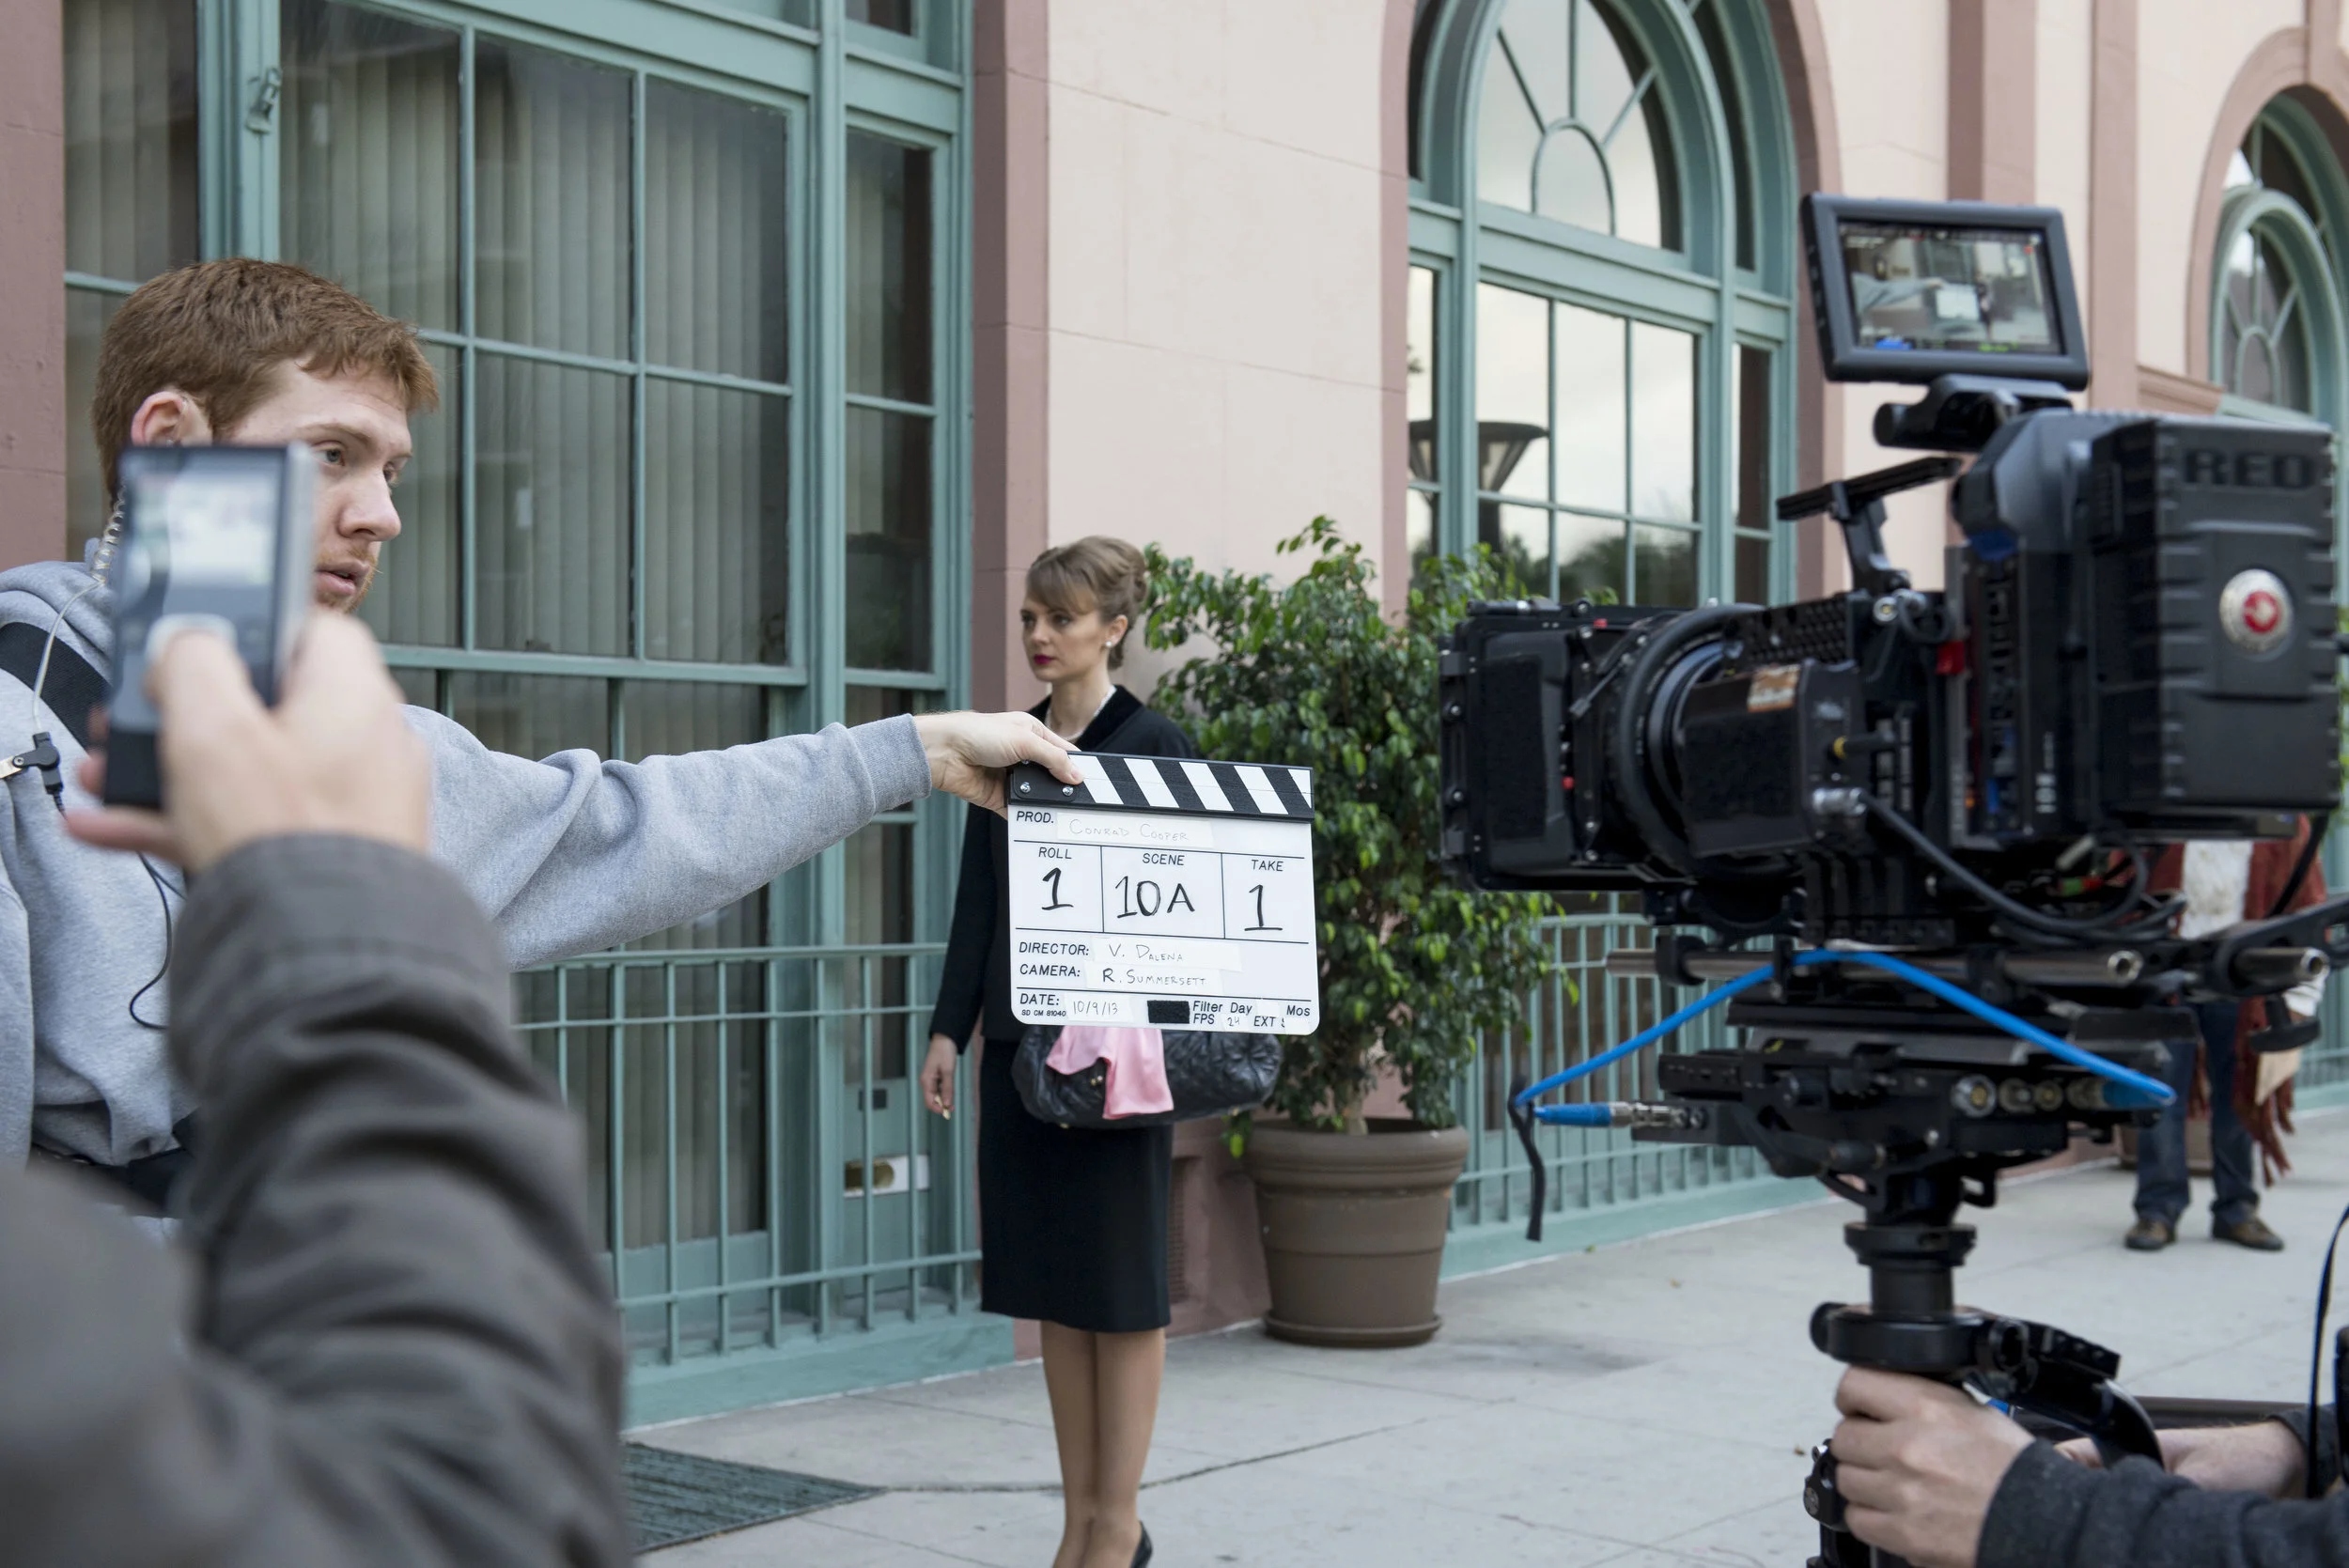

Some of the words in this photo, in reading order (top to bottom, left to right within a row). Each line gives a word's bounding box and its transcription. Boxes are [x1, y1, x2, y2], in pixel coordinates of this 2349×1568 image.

[1016, 810, 1054, 824] PROD.
[1038, 846, 1072, 860] ROLL
[1142, 852, 1186, 866] SCENE
[1251, 859, 1284, 872] TAKE
[1041, 866, 1074, 911] 1
[1114, 875, 1196, 919] 10A
[1243, 883, 1283, 932] 1
[1019, 941, 1090, 956] DIRECTOR:
[1108, 942, 1126, 957] V.
[1019, 963, 1081, 978] CAMERA:
[1102, 967, 1122, 984] R.
[1019, 992, 1060, 1006] DATE:
[1020, 1008, 1032, 1017] SD
[1045, 1009, 1067, 1017] 81040
[1073, 1000, 1118, 1016] 10/9/13
[1192, 1000, 1223, 1013] Filter
[1229, 1001, 1253, 1017] Day
[1285, 1004, 1311, 1017] Mos
[1192, 1013, 1215, 1025] FPS
[1253, 1015, 1277, 1028] EXT
